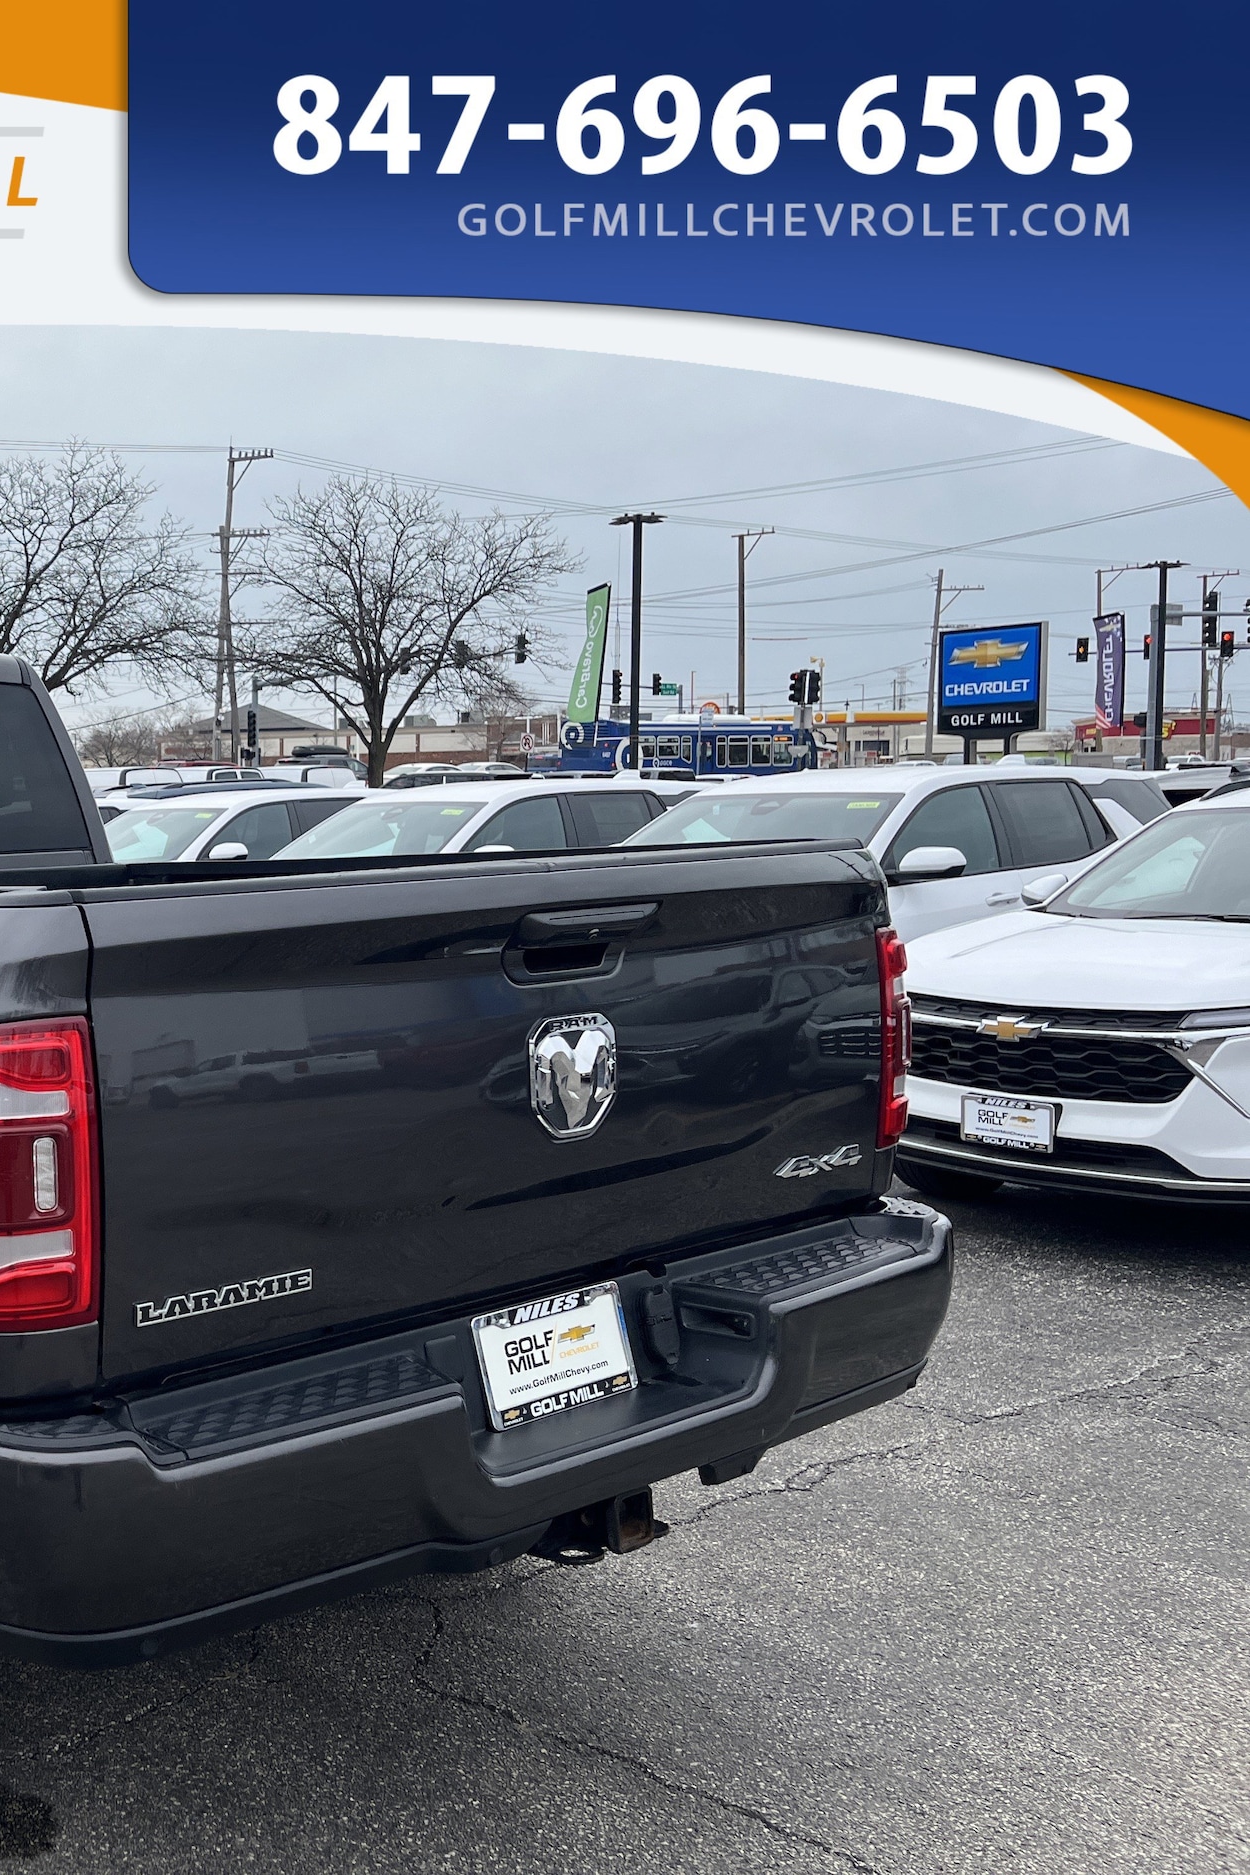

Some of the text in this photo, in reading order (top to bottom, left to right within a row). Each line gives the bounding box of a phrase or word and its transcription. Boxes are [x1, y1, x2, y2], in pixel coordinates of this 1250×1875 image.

[945, 679, 1030, 697] CHEVROLET
[951, 712, 1023, 727] GOLF MILL
[550, 1015, 598, 1032] RAM
[984, 1098, 1028, 1109] NILES
[977, 1109, 1008, 1119] GOLF
[978, 1116, 1003, 1126] MILL
[982, 1136, 1030, 1148] GOLF MILL
[134, 1268, 312, 1328] LARAMIE
[514, 1292, 580, 1324] NILES
[504, 1329, 554, 1358] GOLF
[559, 1341, 599, 1359] CHEVROLET
[507, 1350, 550, 1375] MILL
[509, 1359, 609, 1395] www.GolfMillChevy.com
[530, 1383, 605, 1418] GOLF MILL
